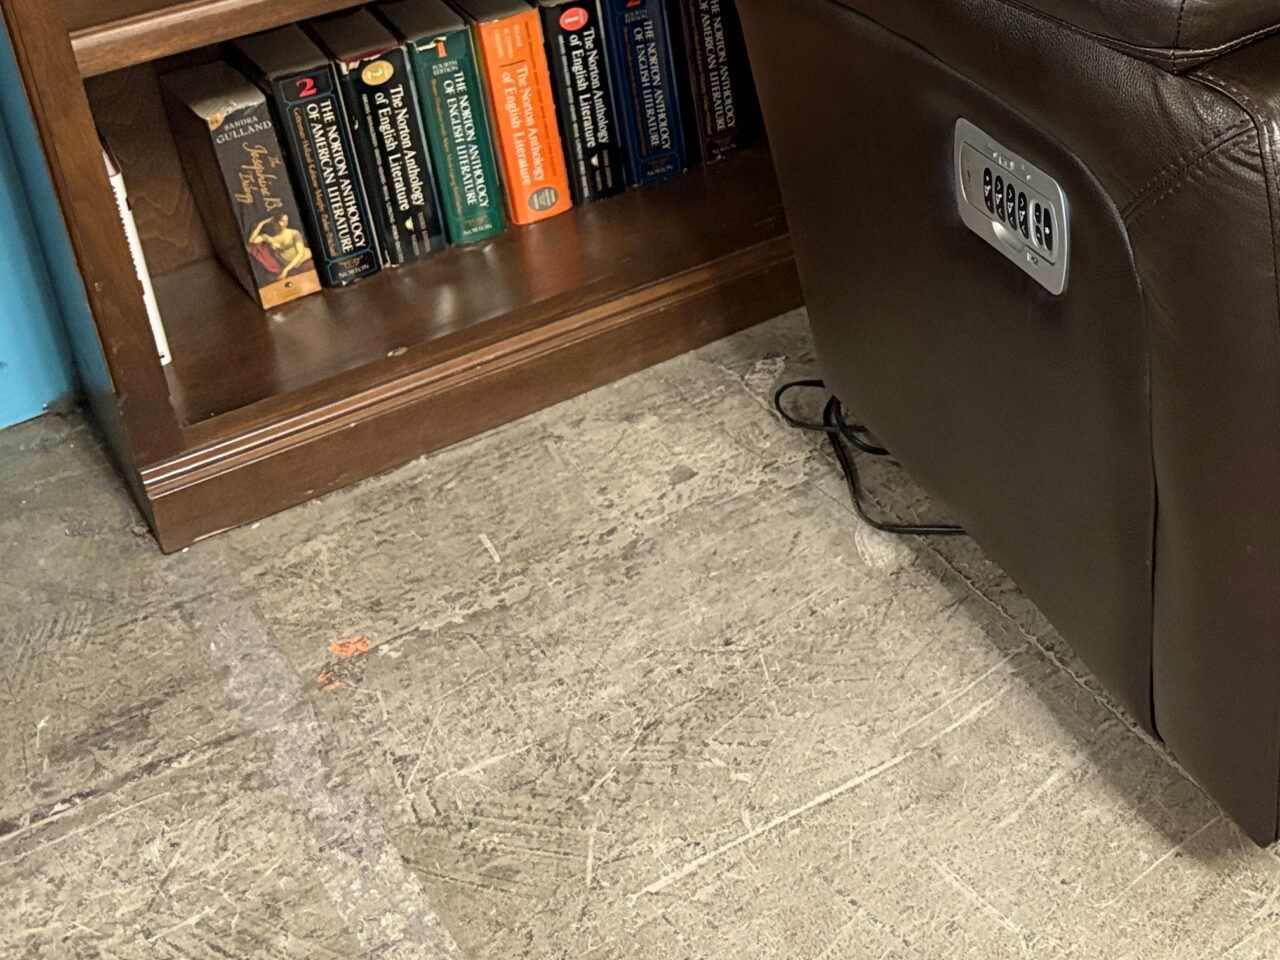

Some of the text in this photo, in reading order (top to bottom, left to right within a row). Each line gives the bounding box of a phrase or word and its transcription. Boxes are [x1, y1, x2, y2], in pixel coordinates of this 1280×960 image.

[569, 34, 578, 47] of
[583, 27, 595, 50] The
[634, 27, 643, 42] OF
[713, 16, 728, 63] NORTON
[502, 71, 511, 84] of
[517, 65, 529, 88] The
[572, 48, 588, 91] English
[587, 49, 601, 88] Norton
[636, 42, 650, 87] ENGLISH
[644, 20, 671, 150] THE NORTON ANTHOLOGY
[700, 12, 718, 70] AMERICAN
[709, 71, 727, 133] LITERATURE
[295, 78, 317, 98] 2
[374, 92, 386, 105] of
[390, 84, 404, 108] The
[443, 79, 455, 95] OF
[505, 85, 521, 129] English
[521, 87, 536, 127] Norton
[720, 64, 736, 128] ANTHOLOGY
[216, 120, 272, 144] GULLAND
[224, 115, 258, 131] SANDRA
[378, 108, 398, 152] English
[395, 109, 412, 149] Norton
[447, 98, 465, 143] ENGLISH
[454, 70, 490, 207] THE NORTON ANTHOLOGY
[579, 93, 597, 148] Literature
[593, 90, 609, 143] Anthology
[643, 89, 660, 148] LITERATURE
[320, 99, 366, 248] THE NORTON ANTHOLOGY
[456, 145, 477, 206] LITERATURE
[513, 131, 532, 186] Literature
[528, 127, 545, 181] Anthology
[306, 103, 354, 253] OF AMERICAN LITERATURE
[388, 154, 410, 211] Literature
[404, 150, 425, 206] Anthology
